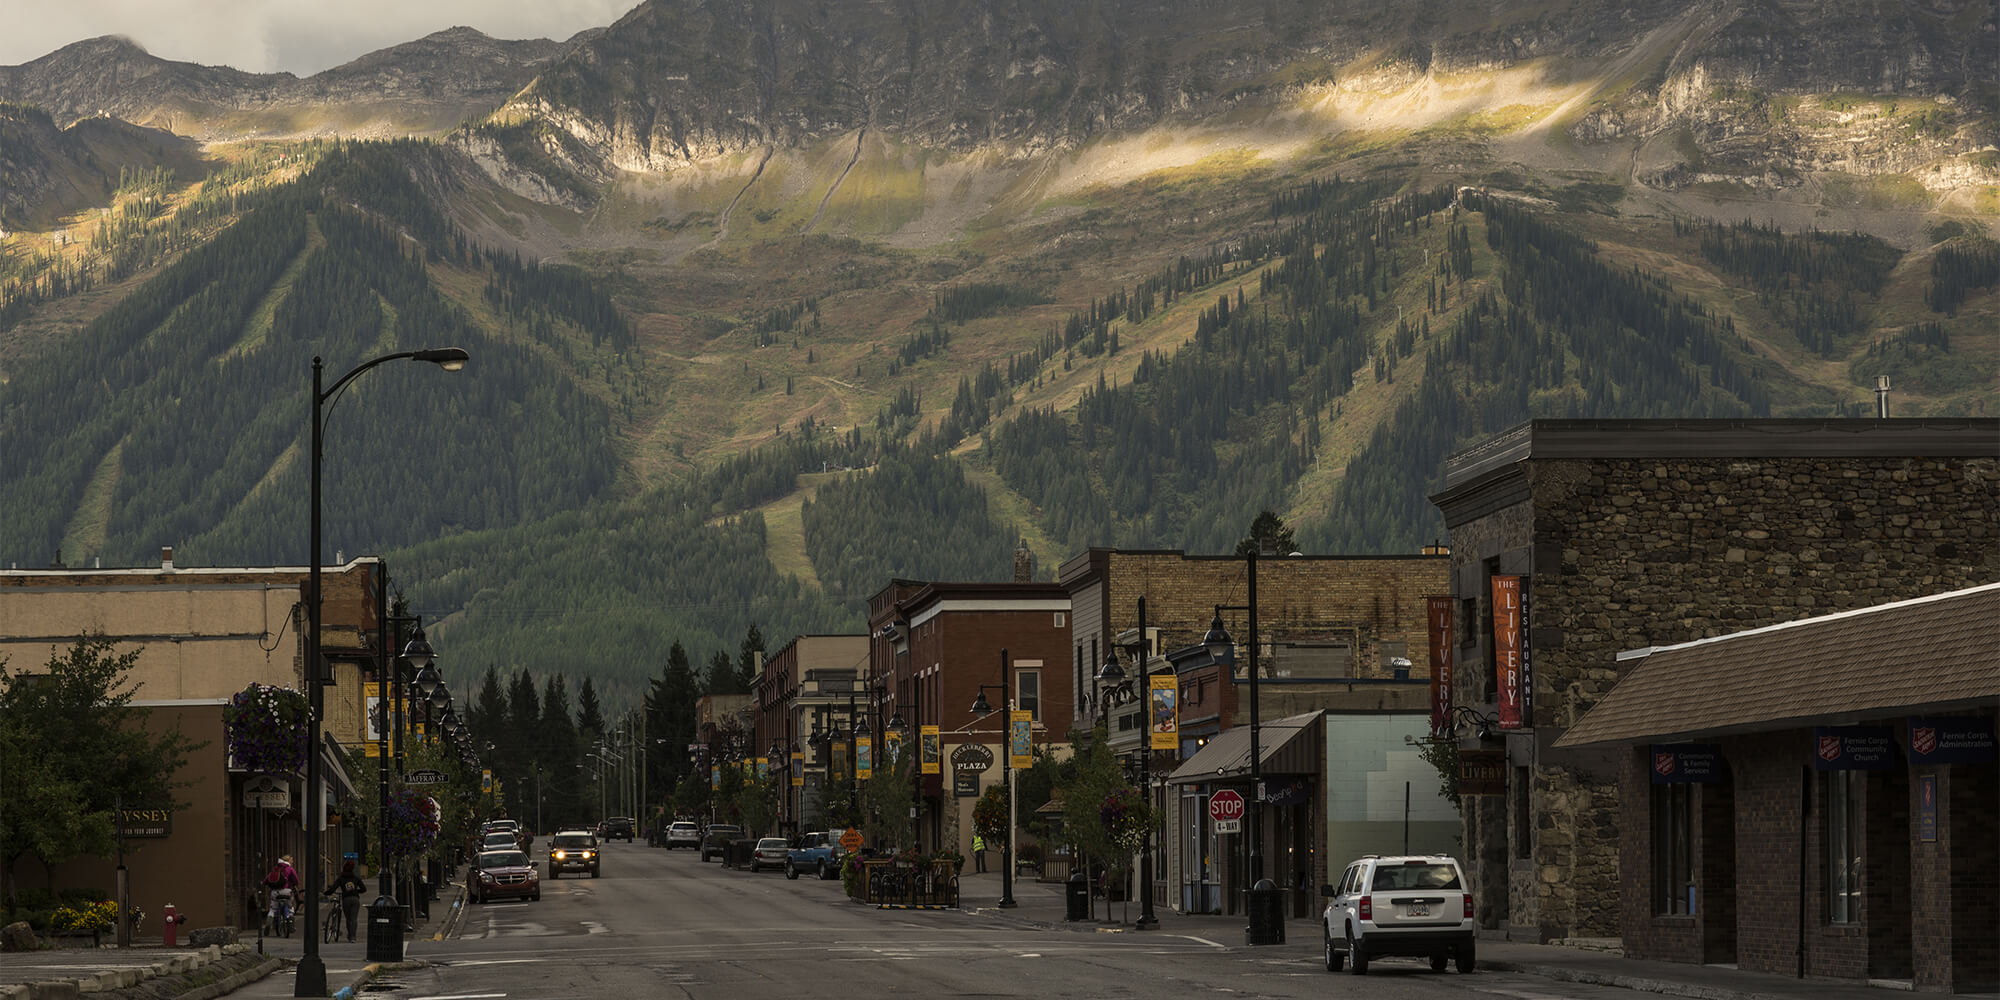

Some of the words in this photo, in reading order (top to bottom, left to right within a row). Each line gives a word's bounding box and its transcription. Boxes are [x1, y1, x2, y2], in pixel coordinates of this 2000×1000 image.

[1497, 580, 1515, 589] THE
[1432, 601, 1448, 609] THE
[1506, 592, 1517, 706] LIVERY
[1522, 593, 1530, 706] RESTAURANT
[1439, 612, 1448, 720] LIVERY
[1943, 732, 1965, 740] Fernie
[1967, 731, 1989, 741] Corps
[1868, 737, 1889, 745] Corps
[1939, 740, 1993, 748] Administration
[1846, 745, 1887, 753] Community
[1461, 767, 1503, 779] LIVERY
[1211, 800, 1242, 815] STOP
[1217, 822, 1237, 831] 4-WAY
